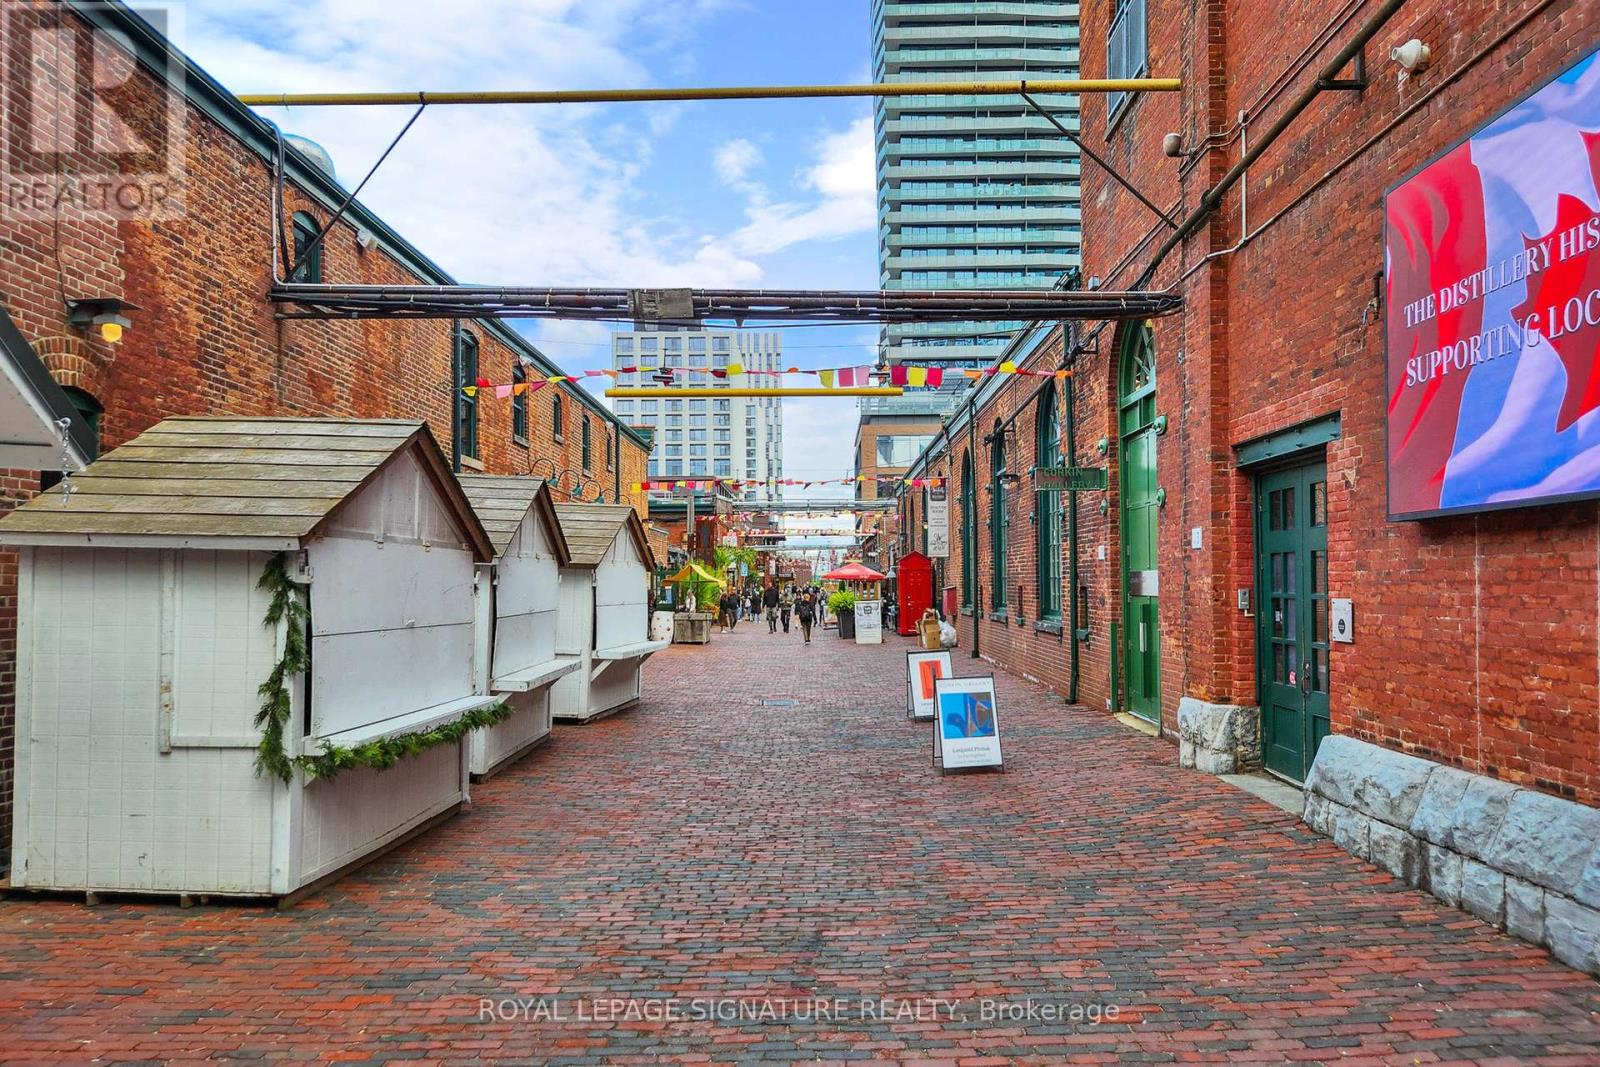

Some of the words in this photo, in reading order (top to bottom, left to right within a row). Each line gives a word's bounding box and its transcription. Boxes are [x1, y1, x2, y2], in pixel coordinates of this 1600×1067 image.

[1404, 293, 1436, 328] THE
[1439, 237, 1554, 314] DISTILLERY
[1558, 216, 1600, 262] HIS
[1406, 312, 1541, 387] SUPPORTING
[1548, 289, 1600, 340] LOC
